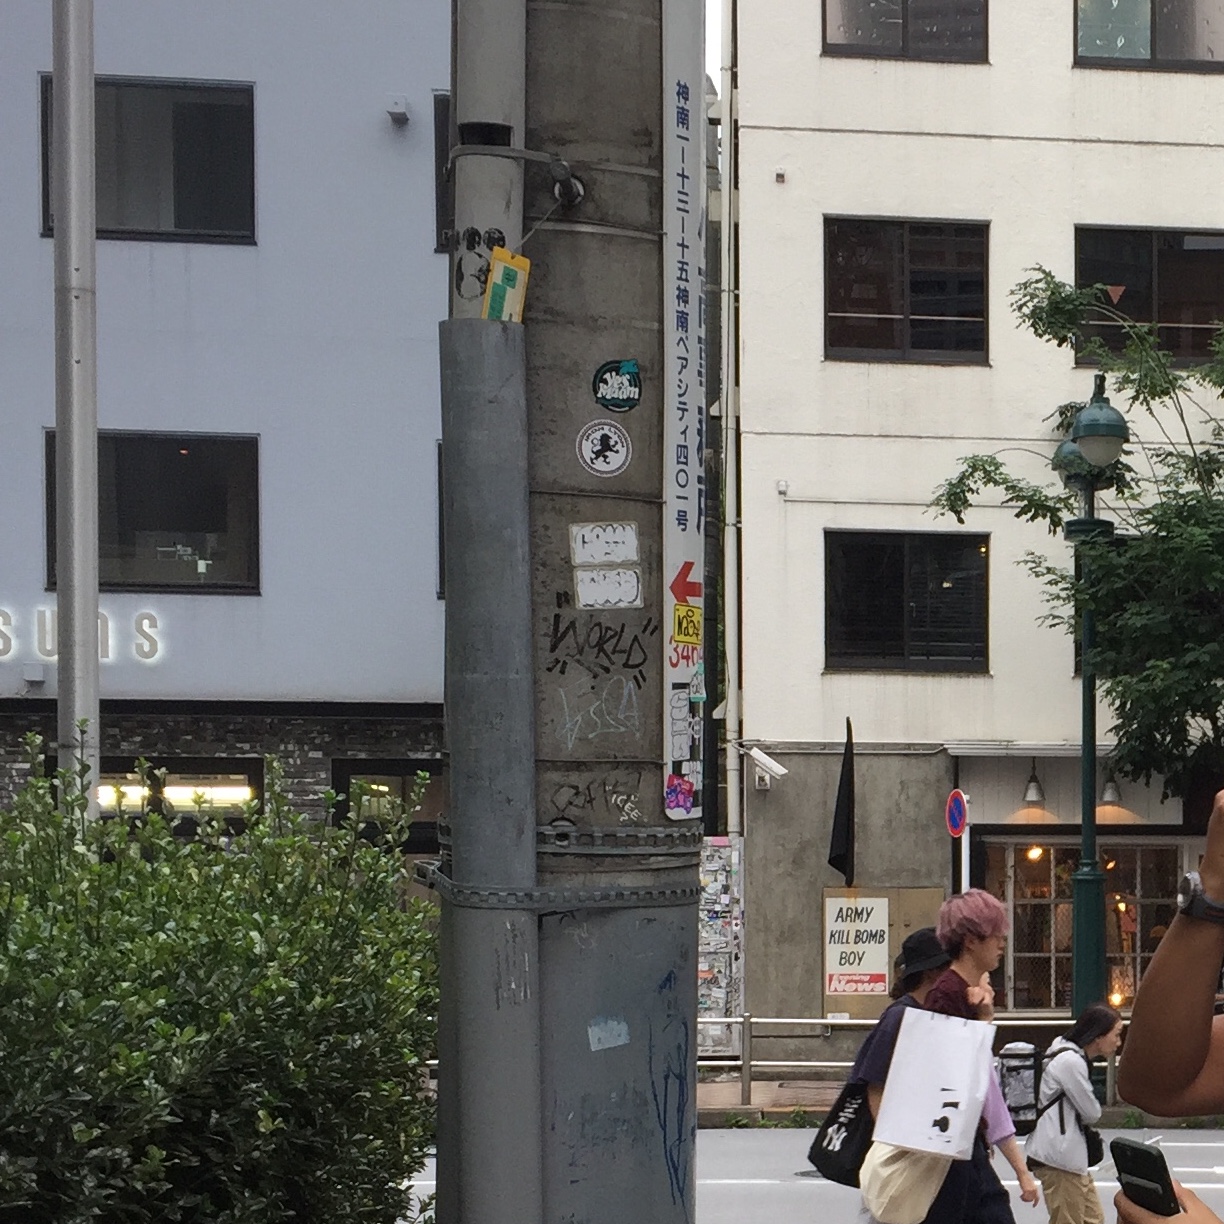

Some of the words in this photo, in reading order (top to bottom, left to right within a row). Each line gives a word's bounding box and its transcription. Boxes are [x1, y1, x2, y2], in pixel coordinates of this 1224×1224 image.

[834, 907, 874, 923] ARMY
[829, 929, 850, 944] KILL
[854, 929, 886, 944] BOMB
[839, 951, 866, 966] BOY
